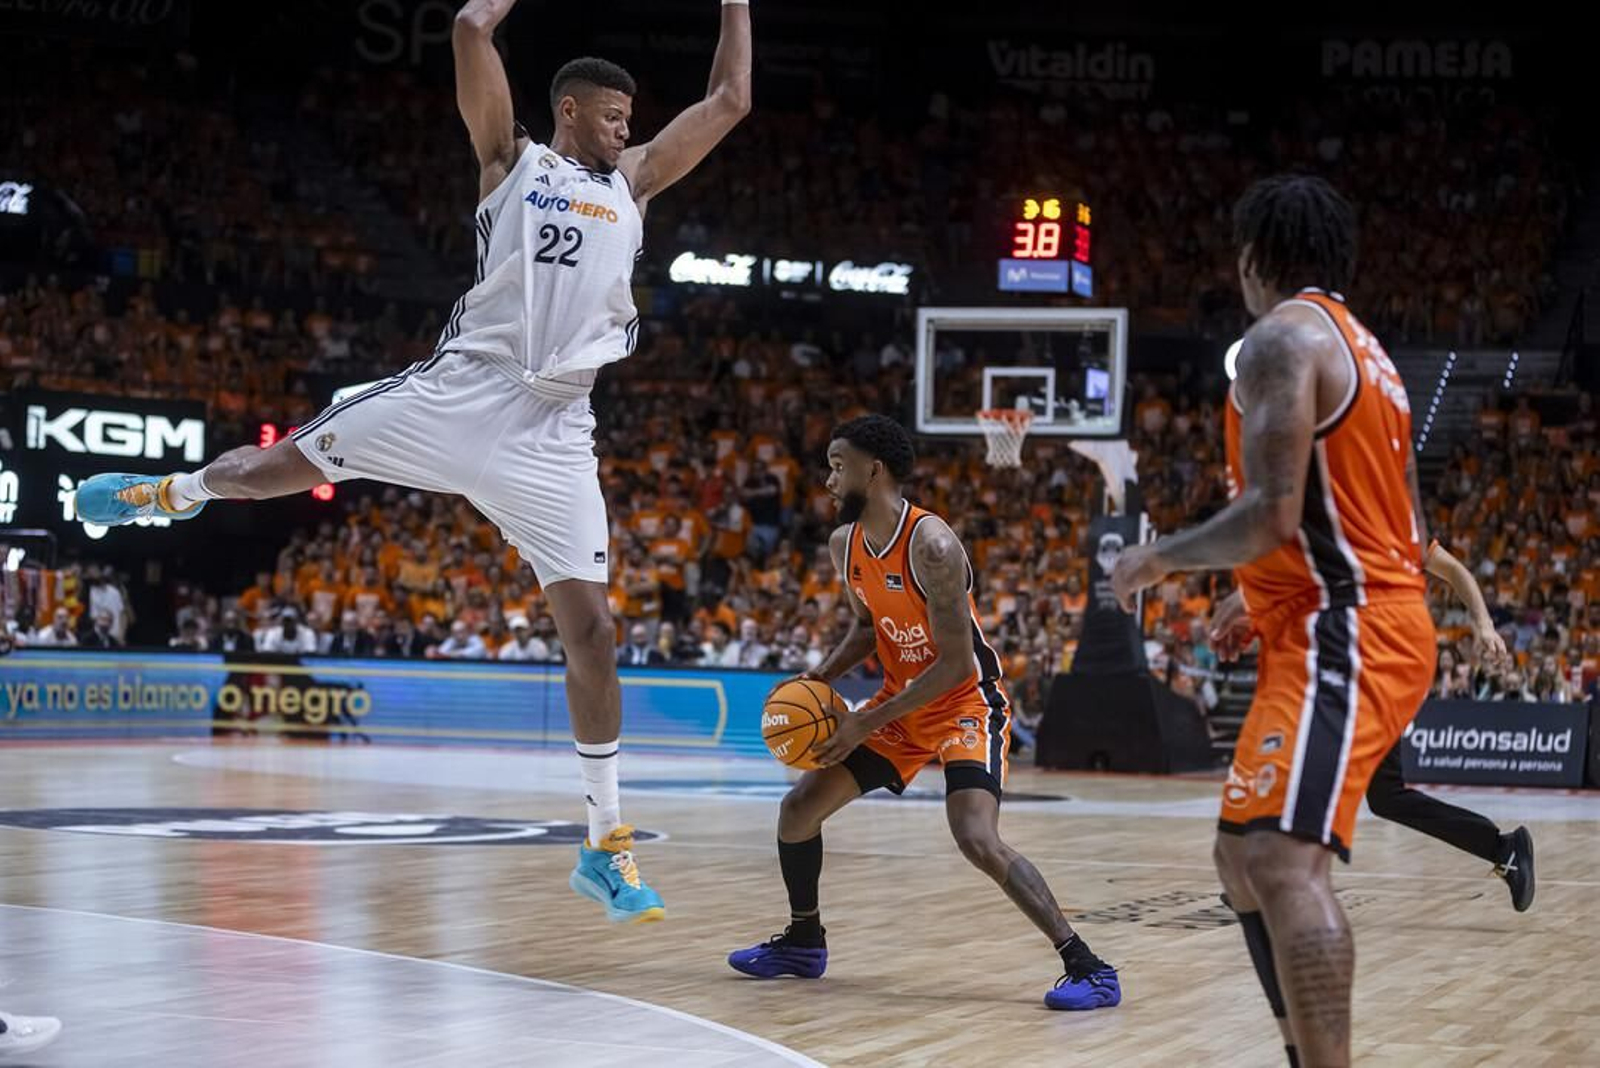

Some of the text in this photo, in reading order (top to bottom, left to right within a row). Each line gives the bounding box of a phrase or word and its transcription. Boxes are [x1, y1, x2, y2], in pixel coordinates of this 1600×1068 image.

[986, 38, 1155, 80] Vitaldin
[1320, 39, 1513, 78] PAMESA
[525, 190, 618, 224] AUTOHERO
[534, 223, 583, 267] 22
[26, 405, 205, 463] KGM
[6, 676, 372, 724] ya no es blanco o negro
